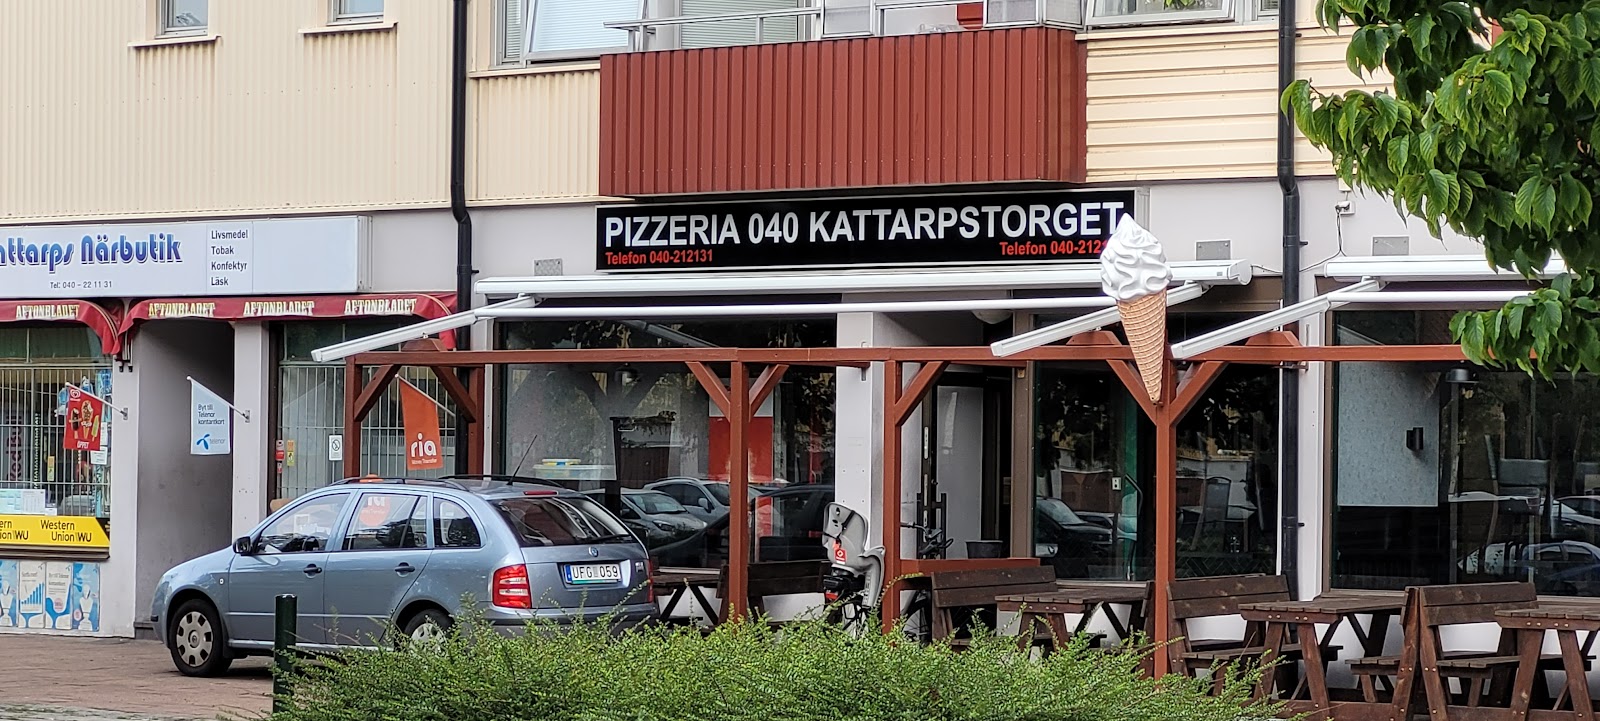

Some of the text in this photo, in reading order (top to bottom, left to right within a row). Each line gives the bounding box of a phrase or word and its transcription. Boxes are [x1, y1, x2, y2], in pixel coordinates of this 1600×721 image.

[604, 201, 1125, 248] PIZZERIA 040 KATTARPSTORGET
[211, 229, 249, 240] Livsmedel
[81, 232, 183, 265] Närbutik
[211, 245, 235, 255] Tobak
[999, 241, 1048, 256] Telefon
[605, 249, 713, 265] Telefon 040-212131
[211, 260, 248, 272] Konfektyr
[62, 281, 76, 289] 040
[211, 276, 229, 286] Läsk
[15, 304, 80, 319] AFTONBLADET
[148, 302, 216, 318] AFTONBLADET
[242, 300, 314, 316] AFTONBLADET
[343, 298, 417, 316] AFTONBLADET
[410, 432, 437, 458] ria
[40, 519, 75, 530] Western
[572, 565, 618, 579] UFG 059
